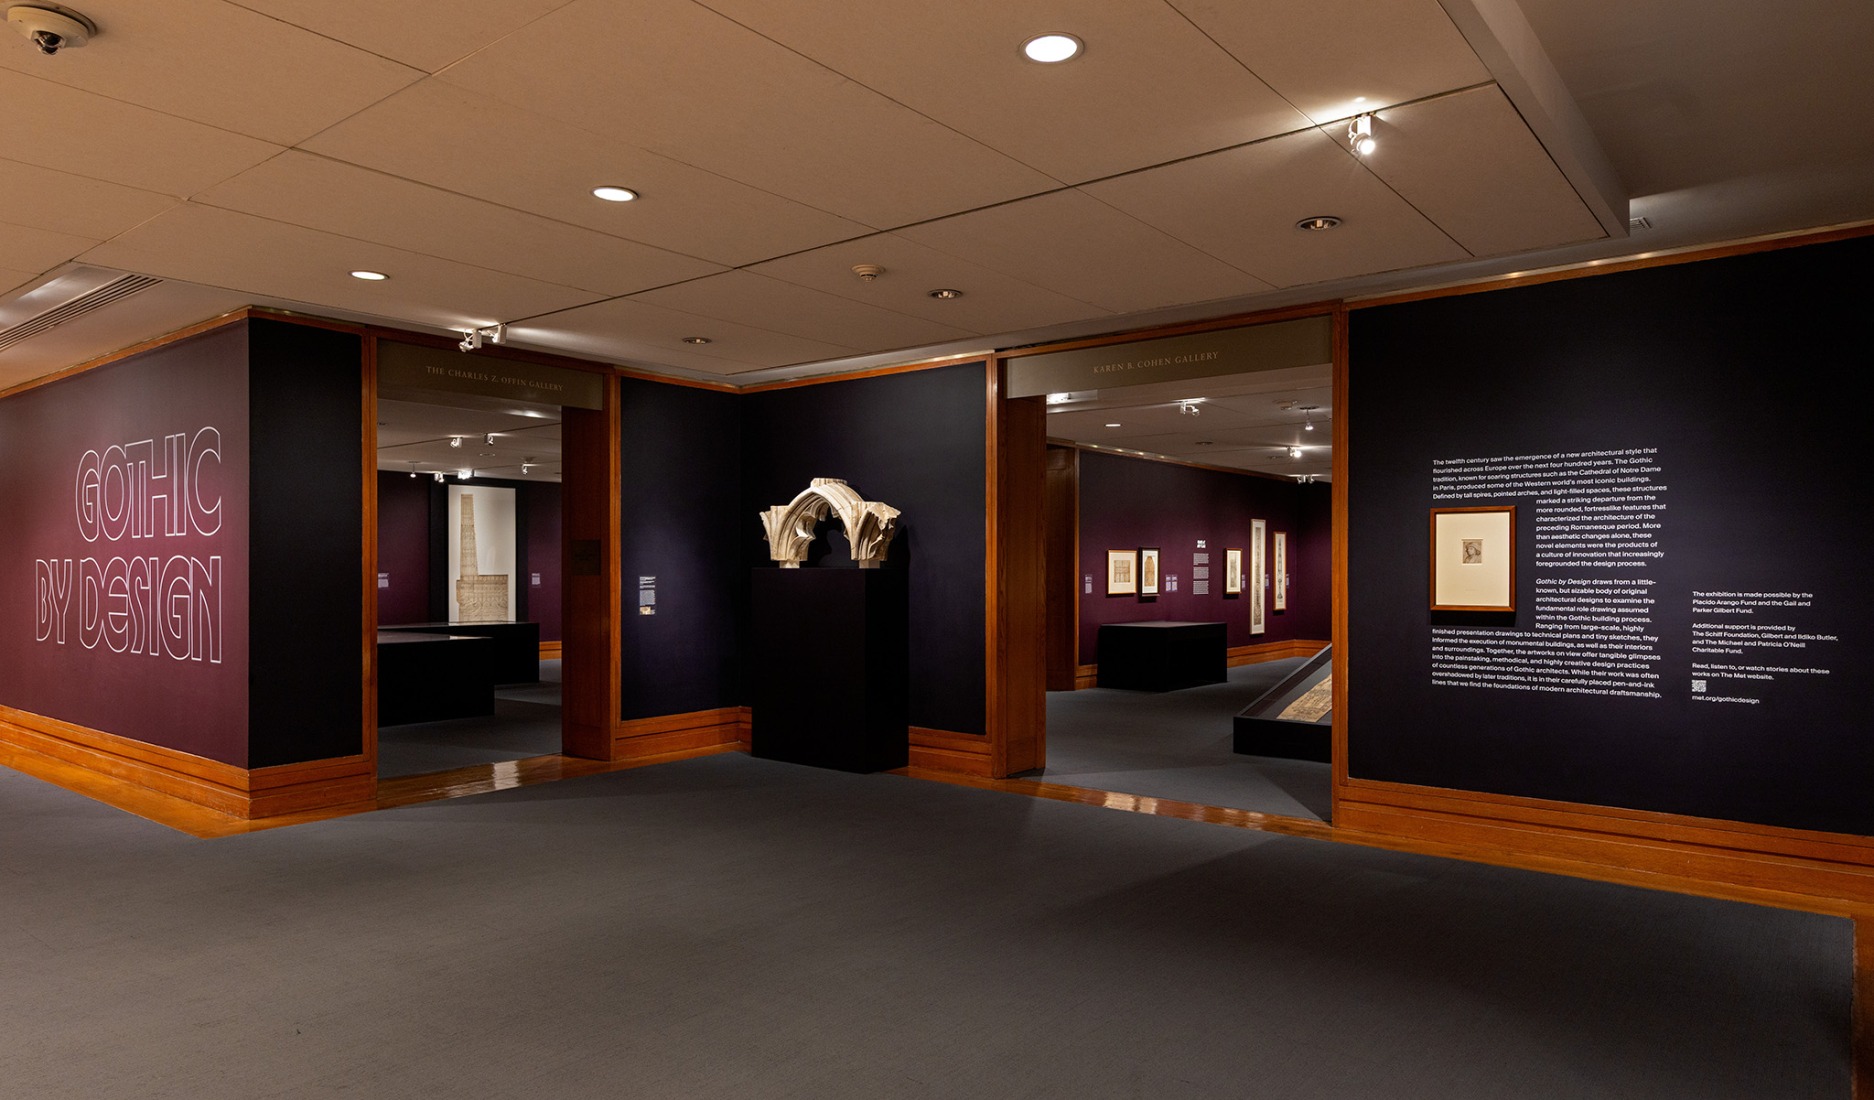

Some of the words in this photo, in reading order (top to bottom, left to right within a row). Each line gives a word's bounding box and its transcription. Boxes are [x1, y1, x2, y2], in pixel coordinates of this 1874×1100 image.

[1093, 363, 1124, 374] KAREN
[1137, 358, 1172, 368] COHEN
[1175, 352, 1219, 364] GALLERY
[426, 366, 445, 375] THE
[448, 369, 489, 382] CHARLES
[501, 376, 526, 386] OFFIN
[529, 379, 563, 392] GALLERY
[1581, 449, 1624, 457] architectural
[75, 426, 222, 543] GOTHIC
[36, 559, 73, 645] BY
[80, 555, 222, 664] DESIGN
[1592, 615, 1620, 623] building
[1536, 623, 1563, 631] Ranging
